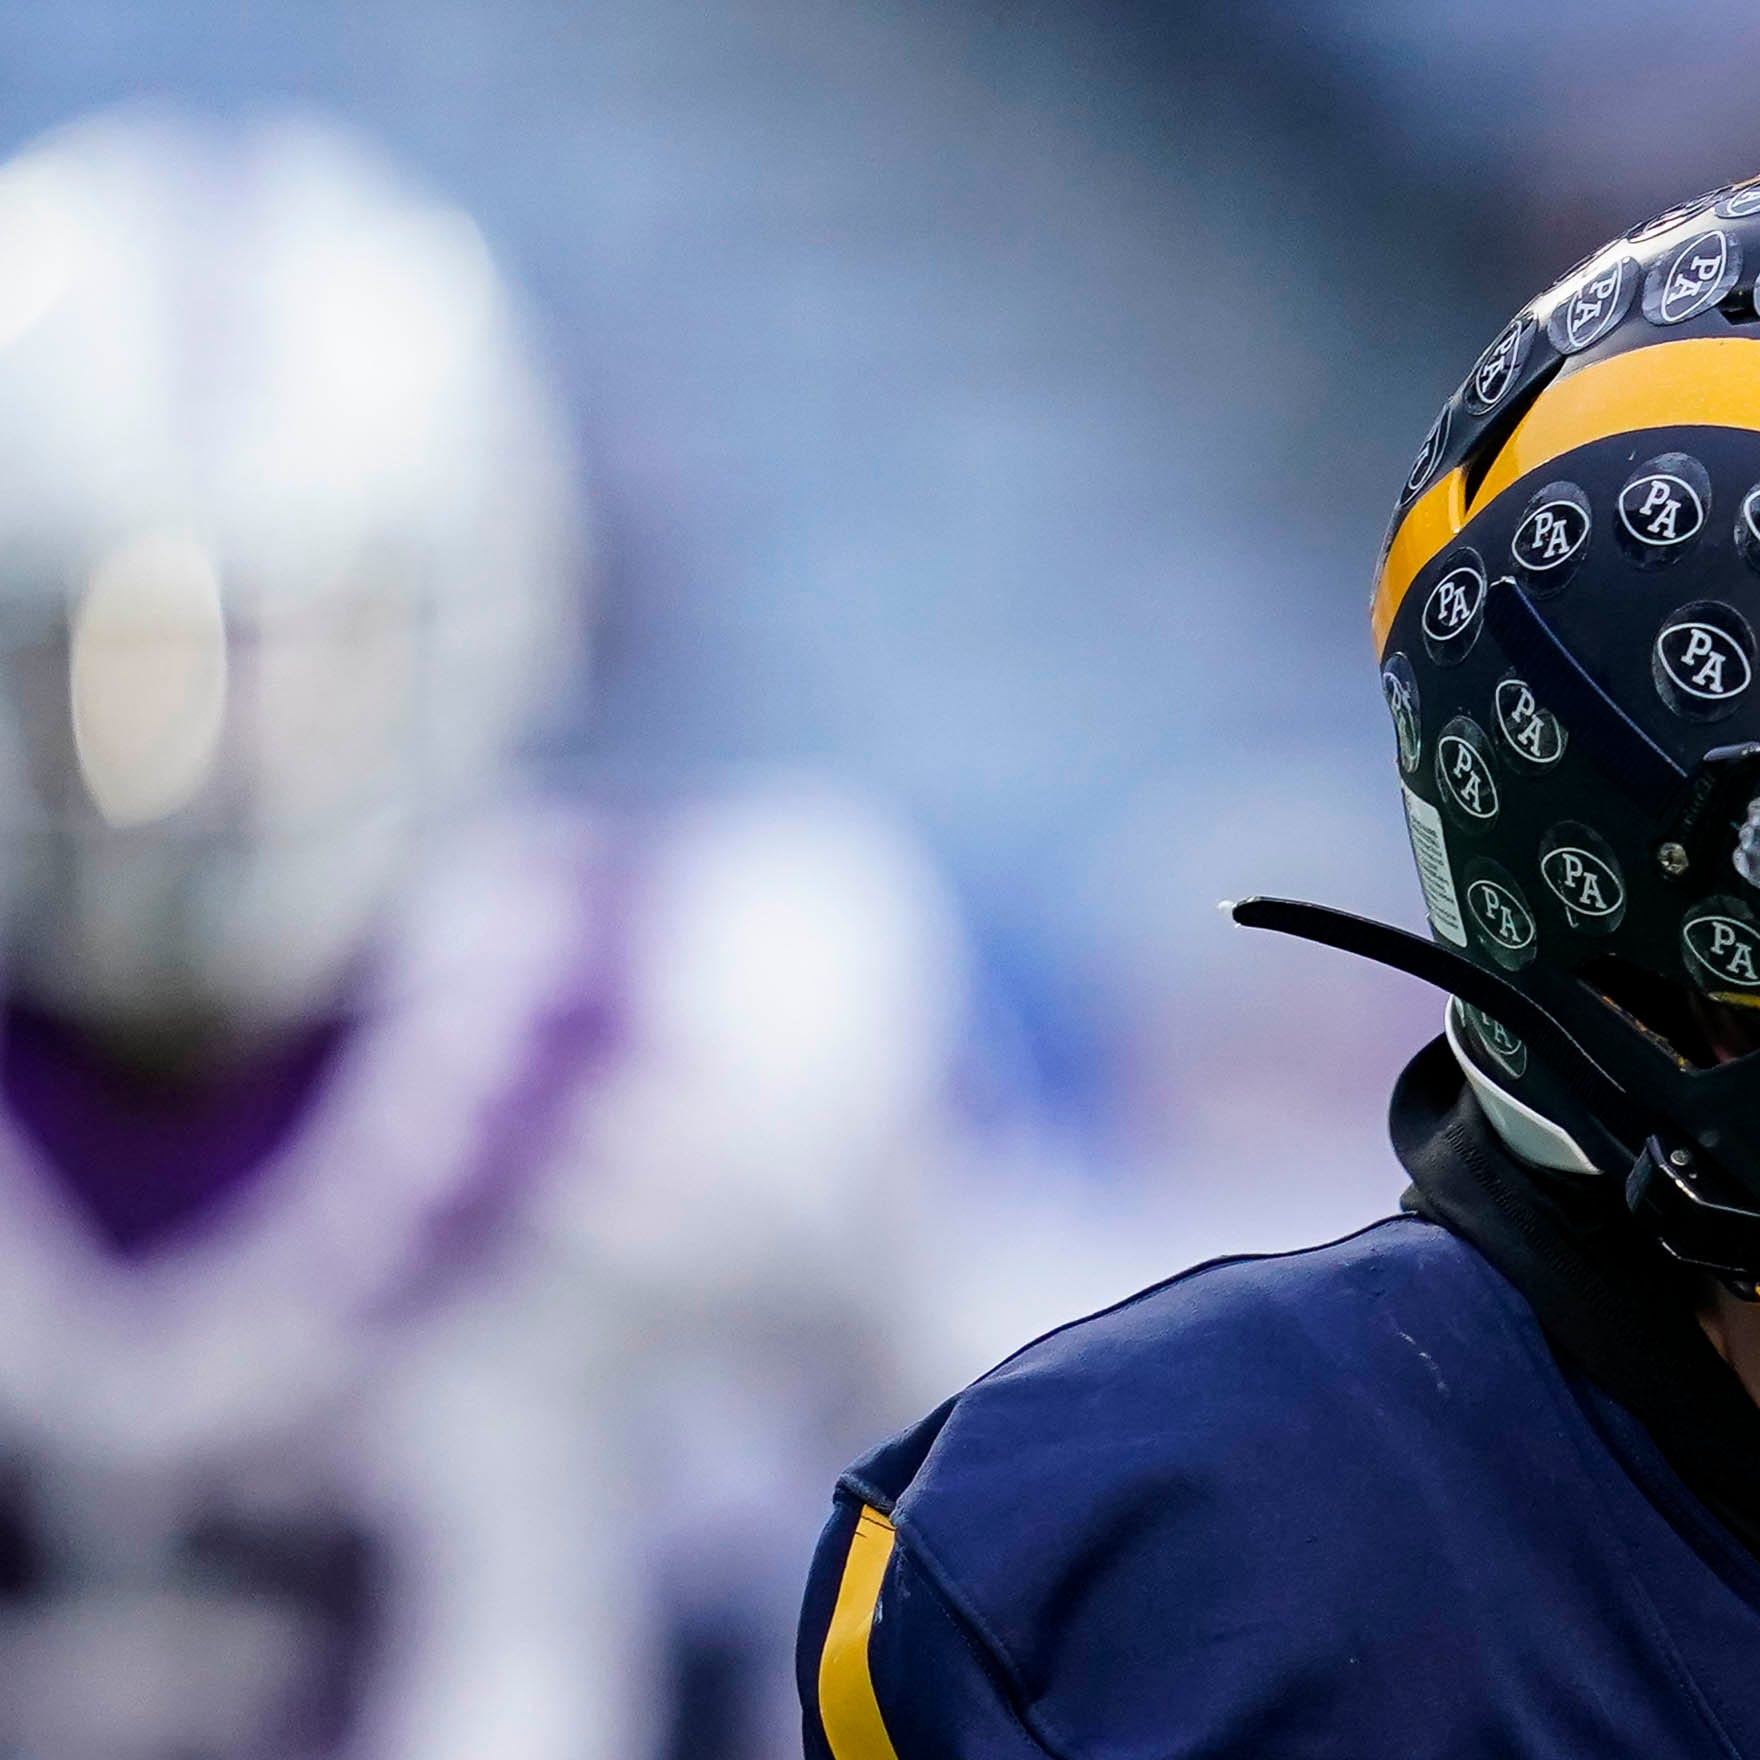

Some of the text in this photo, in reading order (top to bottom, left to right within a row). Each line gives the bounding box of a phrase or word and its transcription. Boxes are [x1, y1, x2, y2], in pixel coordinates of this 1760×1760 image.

[1572, 268, 1619, 333] PA
[1667, 255, 1721, 305] PA
[1481, 334, 1518, 393] PA
[1530, 511, 1571, 559] PA
[1639, 480, 1682, 539] PA
[1437, 581, 1471, 627] PA
[1680, 628, 1726, 693] PA
[1511, 686, 1545, 757] PA
[1453, 743, 1482, 813] PA
[1562, 851, 1608, 910] PA
[1481, 885, 1522, 943] PA
[1709, 921, 1759, 981] PA
